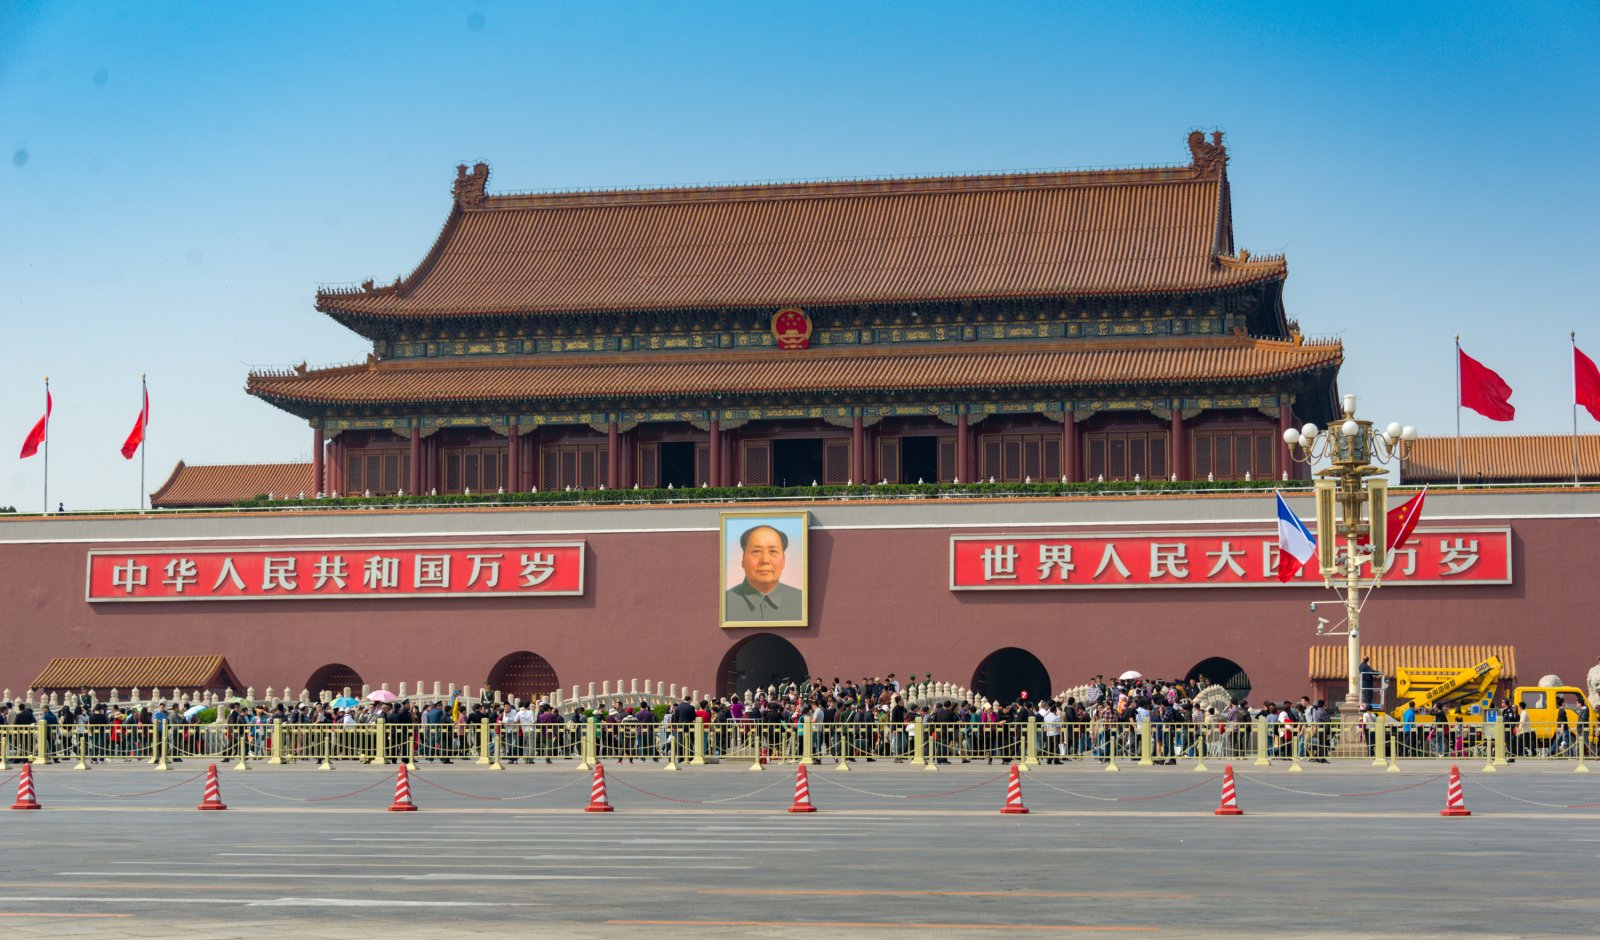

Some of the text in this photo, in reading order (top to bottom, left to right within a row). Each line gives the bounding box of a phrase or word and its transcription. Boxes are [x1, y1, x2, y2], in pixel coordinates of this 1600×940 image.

[112, 552, 555, 592] 中华人民共和国万岁
[980, 538, 1479, 581] 世界人民大万岁
